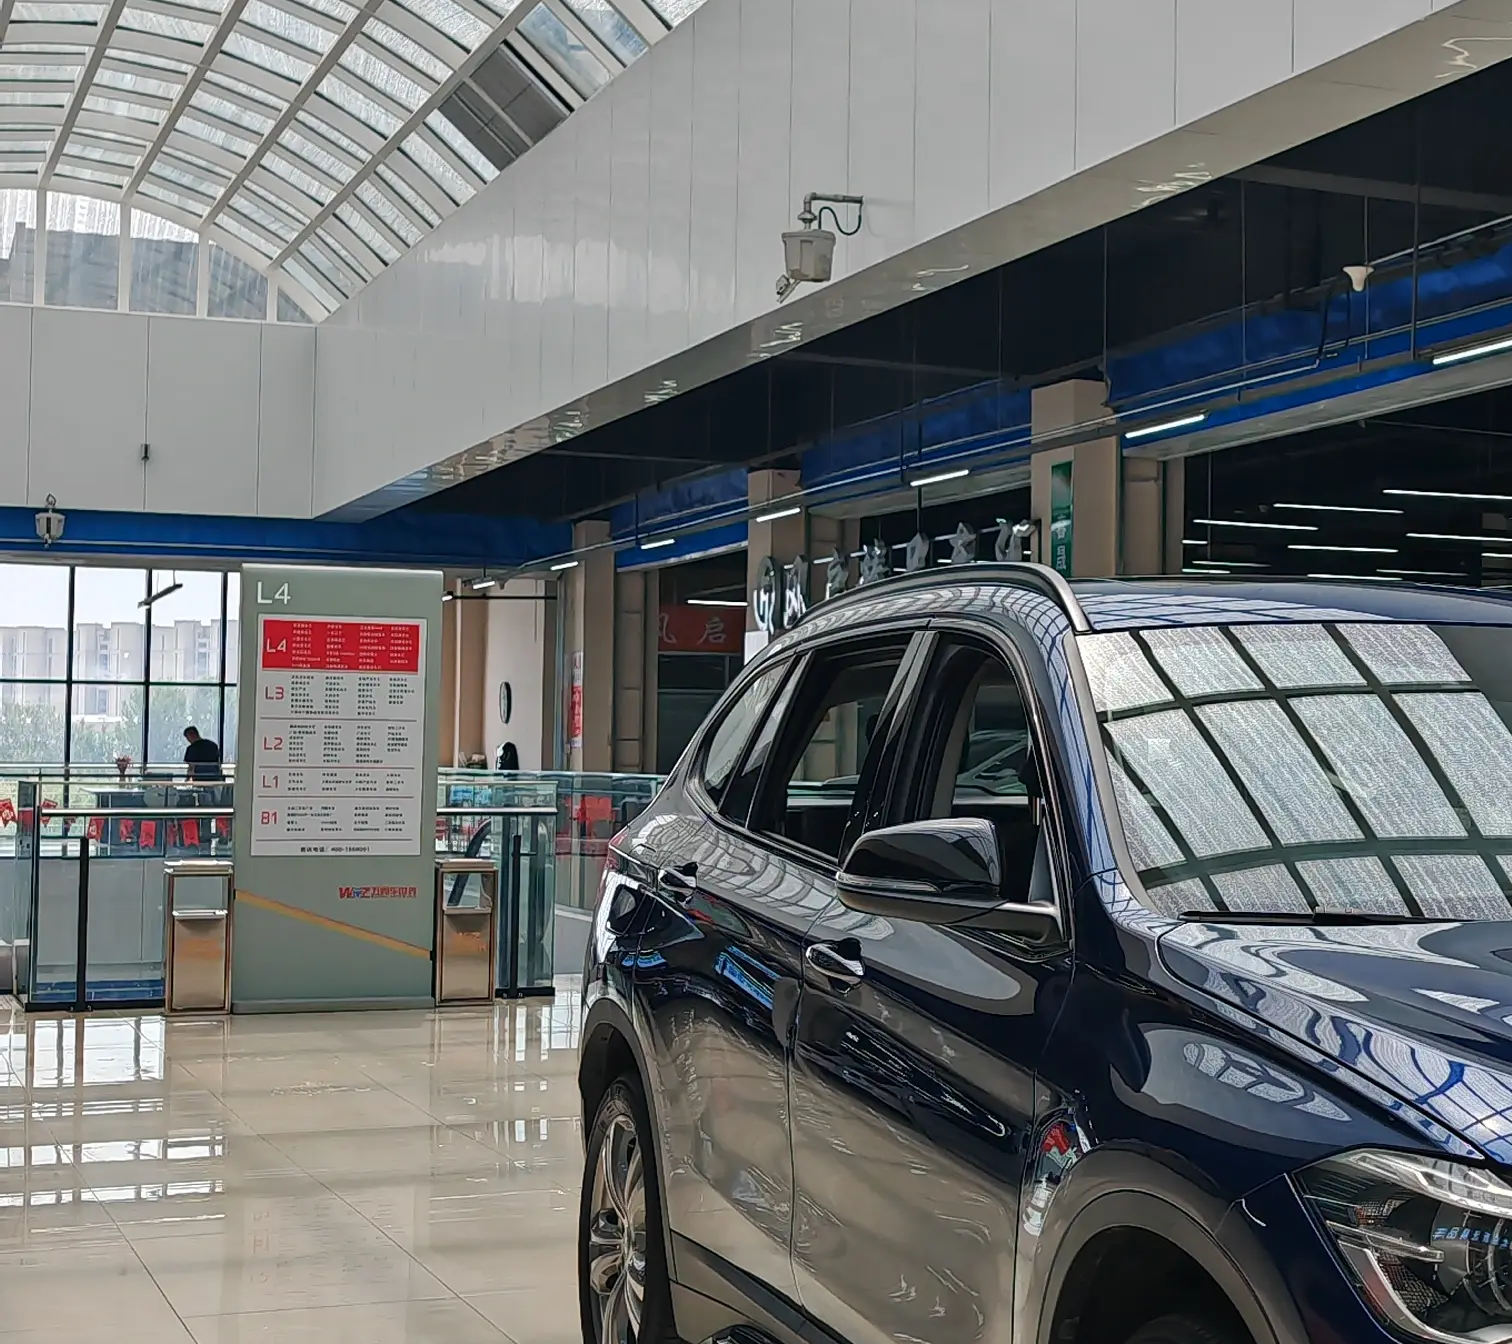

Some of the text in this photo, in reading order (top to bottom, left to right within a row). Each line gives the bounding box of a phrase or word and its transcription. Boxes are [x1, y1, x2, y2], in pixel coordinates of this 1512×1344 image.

[257, 581, 291, 605] L4
[266, 639, 288, 653] L4
[265, 686, 285, 701] L3
[263, 736, 283, 751] L2
[262, 775, 279, 789] L1
[261, 811, 278, 825] B1
